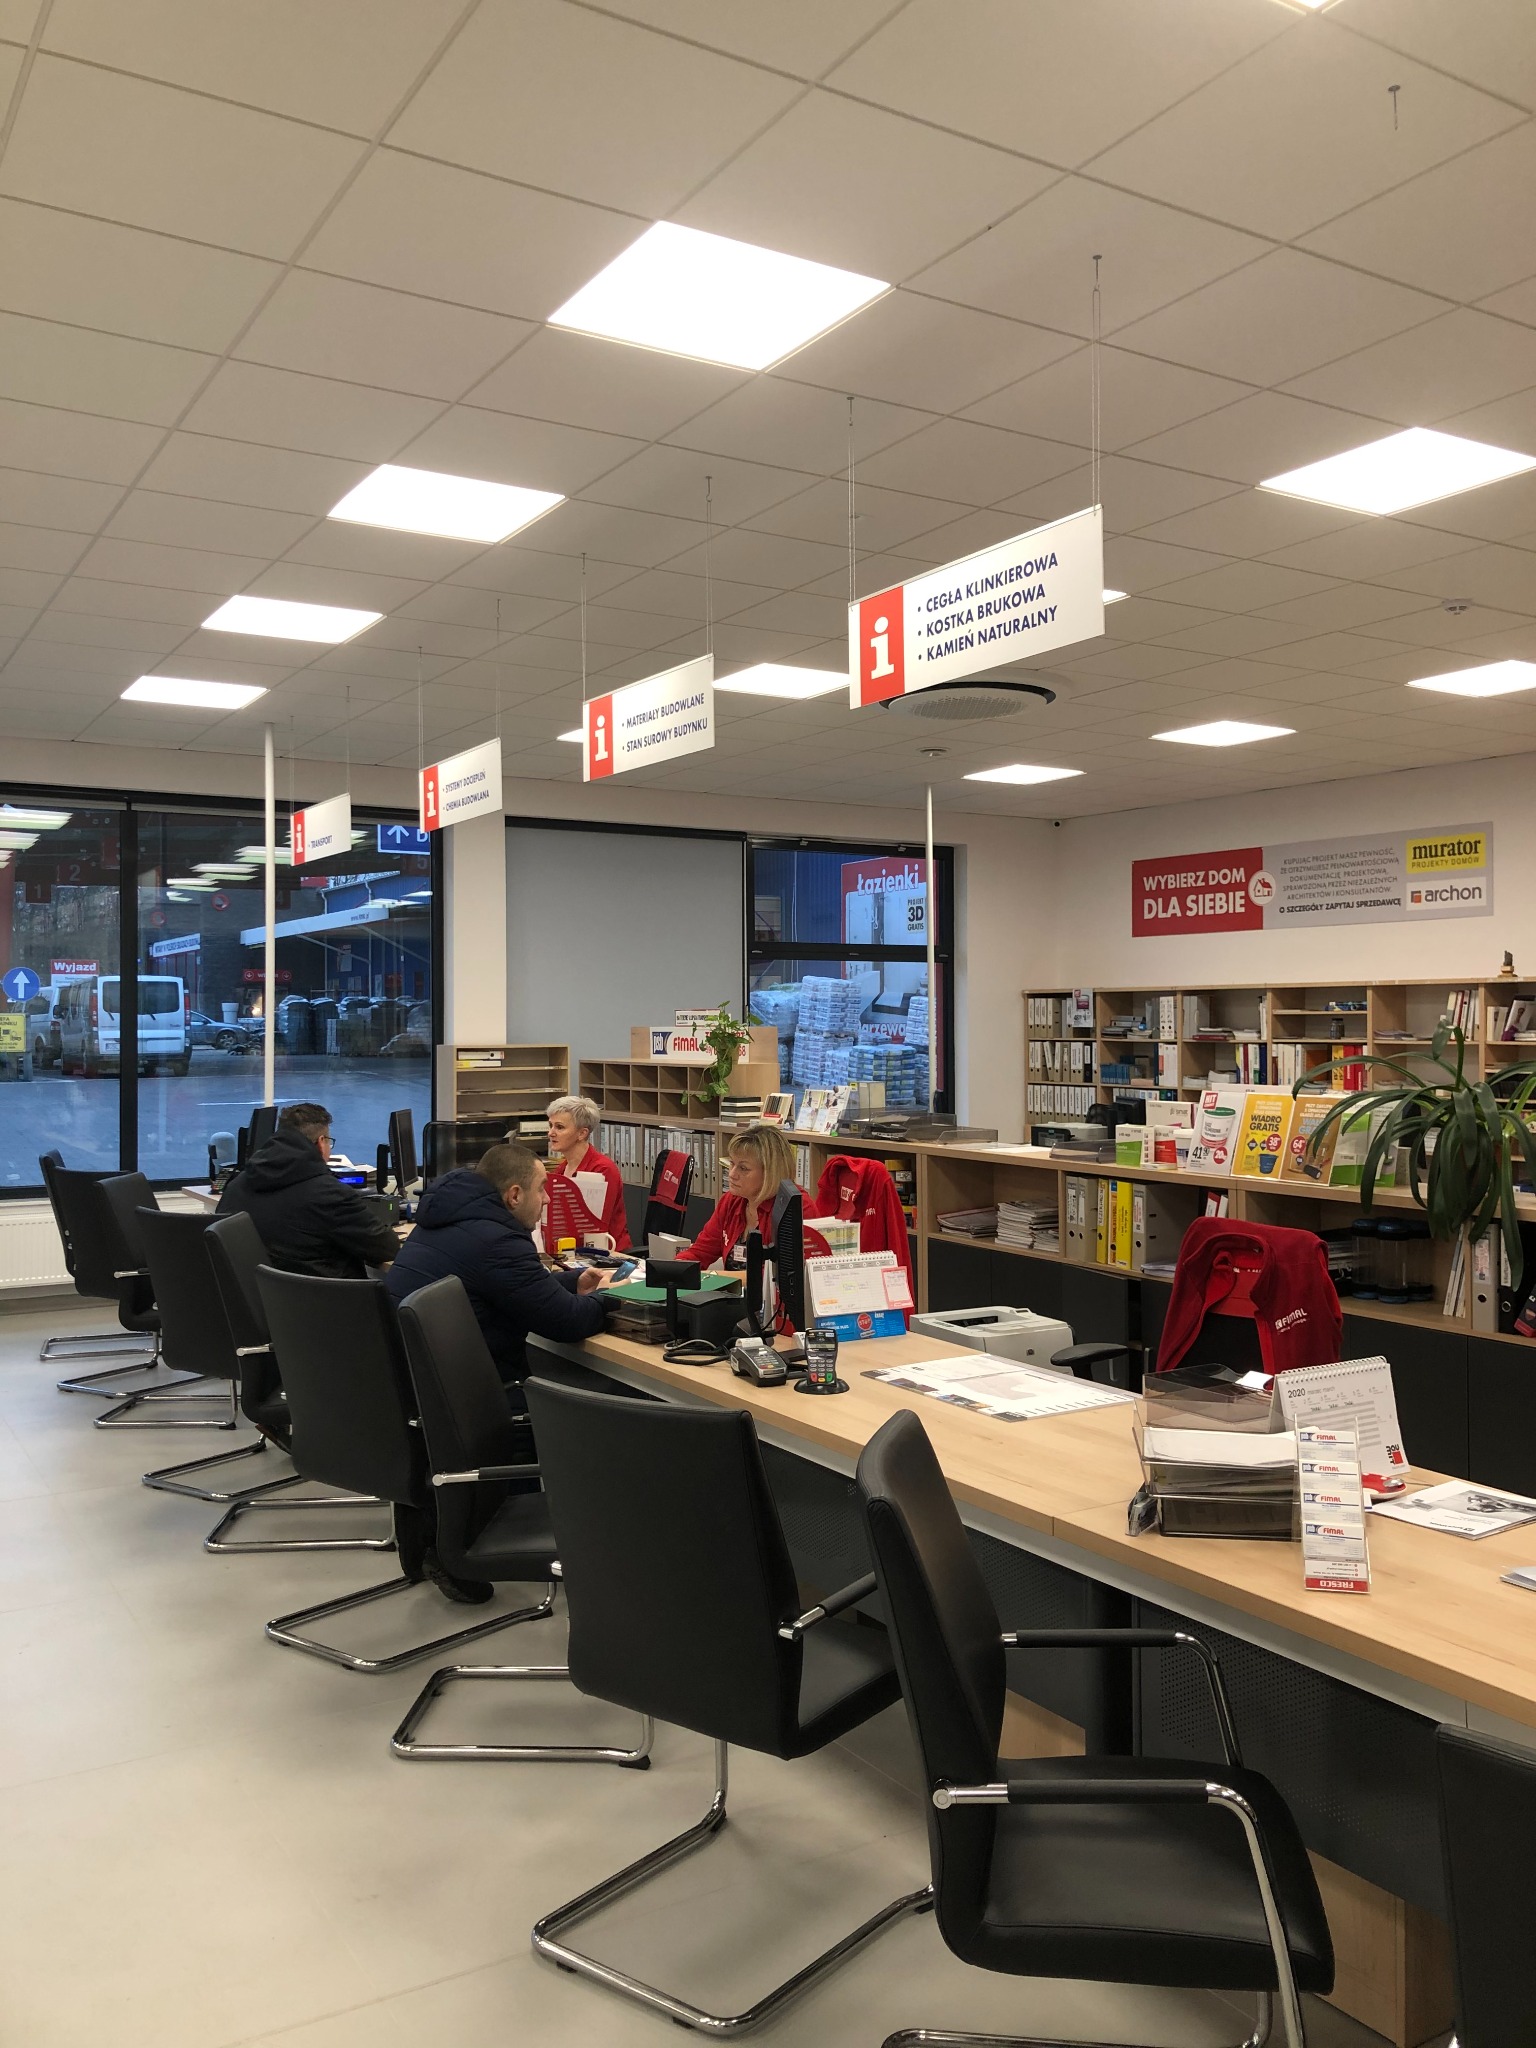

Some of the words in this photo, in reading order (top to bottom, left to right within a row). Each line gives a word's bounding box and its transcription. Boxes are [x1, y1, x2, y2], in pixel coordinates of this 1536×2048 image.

[926, 590, 963, 614] CEGŁA
[965, 552, 1058, 596] KLINKIEROWA
[926, 609, 974, 638] KOSTKA
[977, 583, 1046, 620] BRUKOWA
[927, 628, 974, 662] KAMIEŃ
[977, 605, 1058, 646] NATURALNY
[626, 708, 660, 729] MATERIAŁY
[660, 693, 705, 718] BUDOWLANE
[626, 736, 643, 752] STAN
[643, 728, 673, 746] SUROWY
[674, 717, 708, 738] BUDYNKU
[461, 789, 490, 807] BUDOWLANA
[310, 835, 333, 849] TRANSPORT
[1412, 839, 1481, 860] murator
[1283, 856, 1311, 865] KUPUJĄC
[1312, 853, 1338, 863] PROJEKT
[1339, 851, 1358, 860] MASZ
[1411, 859, 1449, 868] PROJEKTY
[1451, 856, 1480, 866] DOMÓW
[857, 863, 919, 896] Łazienki
[1143, 871, 1206, 891] WYBIERZ
[1208, 867, 1246, 886] DOM
[1282, 881, 1327, 892] SPRAWDZONĄ
[1327, 880, 1346, 888] PRZEZ
[1347, 876, 1398, 887] NIEZALEŻNYCH
[1289, 873, 1341, 883] DOKUMENTACJĘ
[907, 897, 924, 906] PROJEKT
[1287, 891, 1331, 900] ARCHITEKTÓW
[1424, 885, 1482, 903] archon
[1143, 896, 1182, 919] DLA
[1186, 891, 1245, 917] SIEBIE
[1286, 903, 1324, 914] SZCZEGÓŁY
[1325, 901, 1354, 911] ZAPYTAJ
[1356, 898, 1402, 909] SPRZEDAWCĘ
[907, 906, 924, 922] 3D
[907, 922, 924, 931] GRATIS
[54, 962, 97, 973] Wyjazd
[1249, 1122, 1280, 1132] GRATIS
[1251, 1115, 1282, 1124] WIADRO
[1287, 1388, 1306, 1399] 2020
[1320, 1580, 1354, 1589] FRESCO
